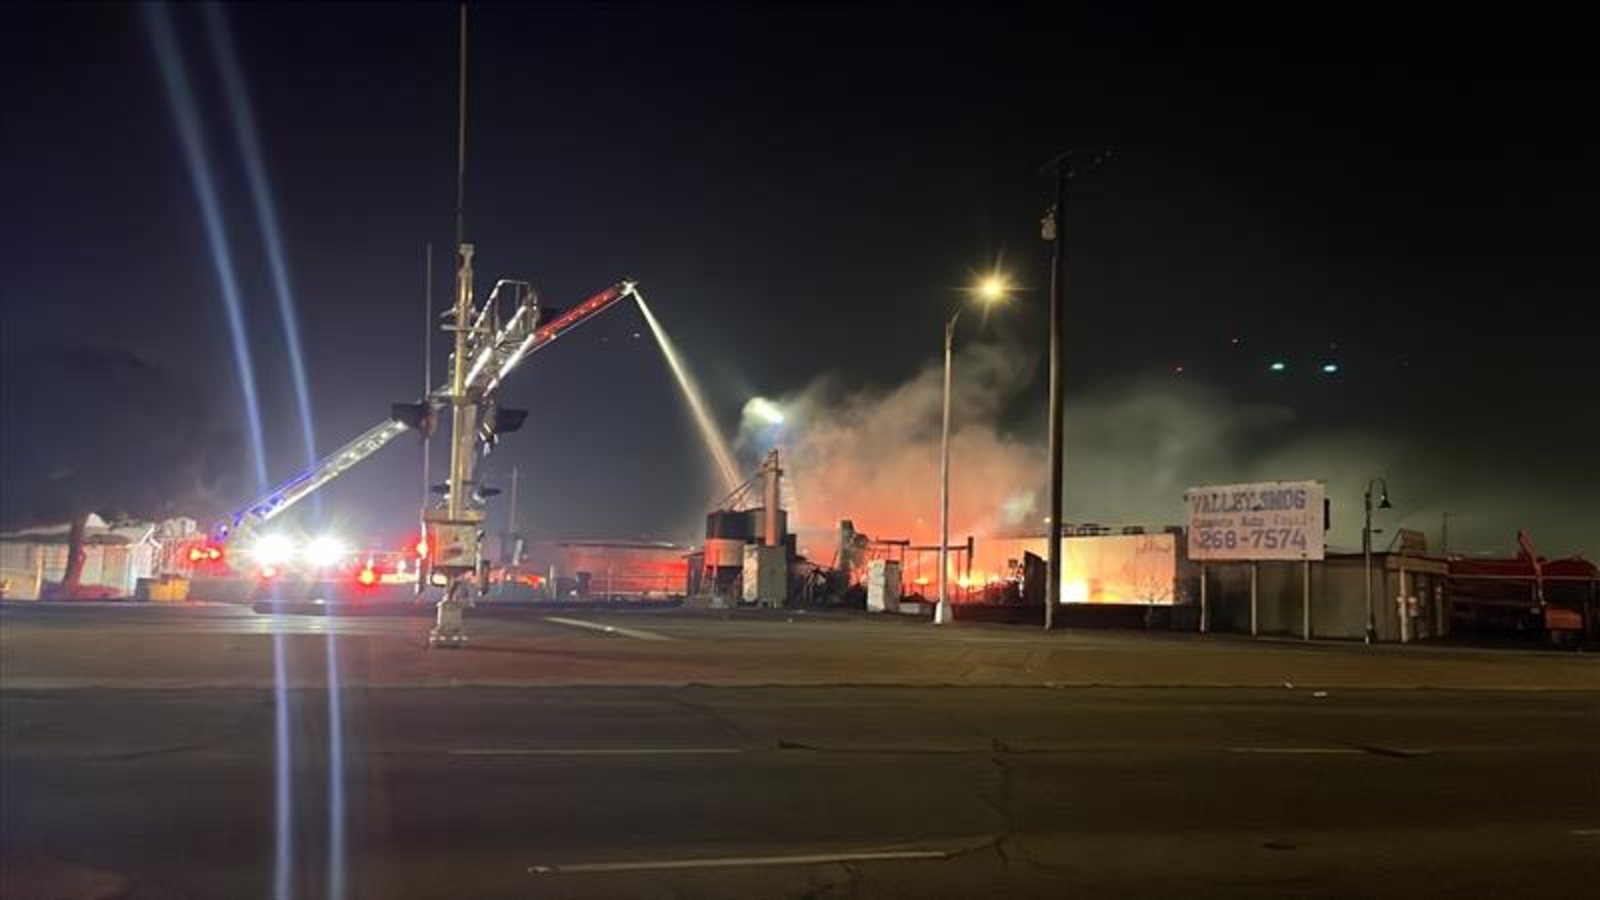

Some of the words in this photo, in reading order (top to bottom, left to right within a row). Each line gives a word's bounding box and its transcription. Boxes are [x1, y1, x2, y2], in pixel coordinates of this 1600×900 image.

[1191, 491, 1255, 513] VALLEY
[1260, 489, 1306, 511] SMOG
[1199, 530, 1307, 550] 268-7574
